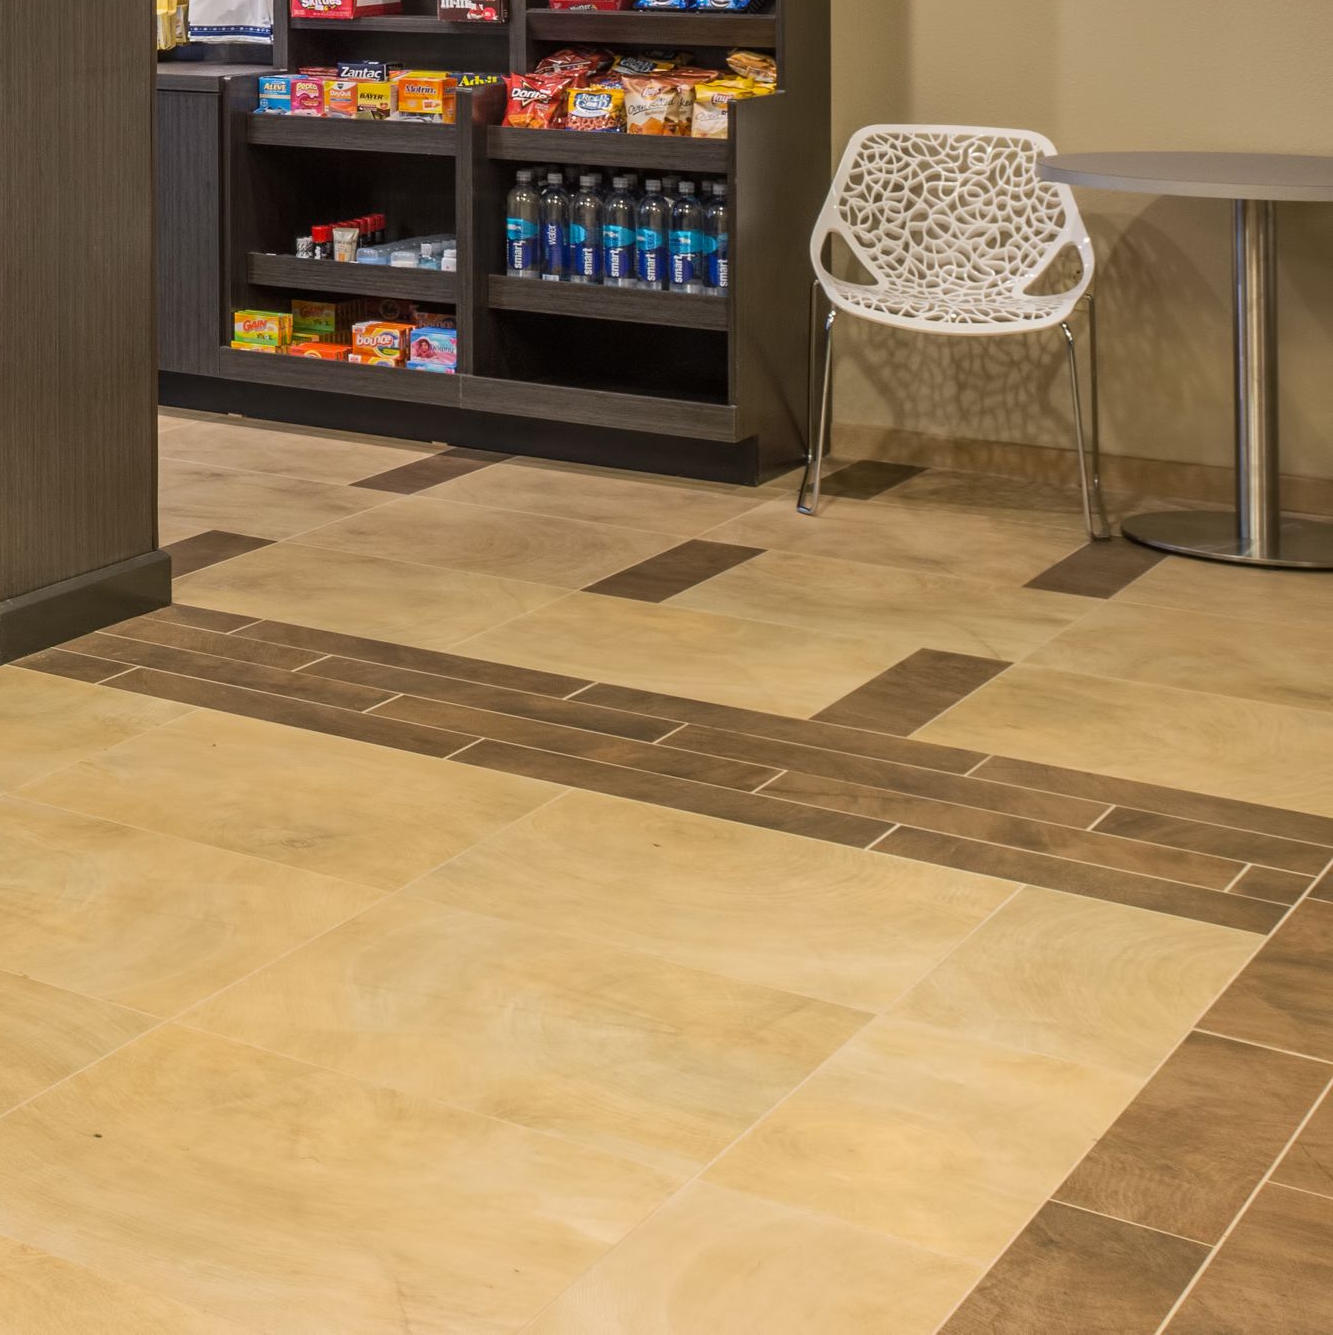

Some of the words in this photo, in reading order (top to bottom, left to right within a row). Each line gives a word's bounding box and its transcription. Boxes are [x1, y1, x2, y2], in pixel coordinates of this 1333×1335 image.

[341, 66, 383, 78] Zantac
[359, 93, 384, 101] BAYER
[548, 224, 557, 245] water
[514, 240, 526, 269] smart
[583, 247, 593, 275] smart
[610, 248, 623, 277] smart
[646, 253, 656, 281] smart
[674, 253, 684, 283] smart
[718, 259, 728, 287] smart
[356, 334, 392, 347] bounce
